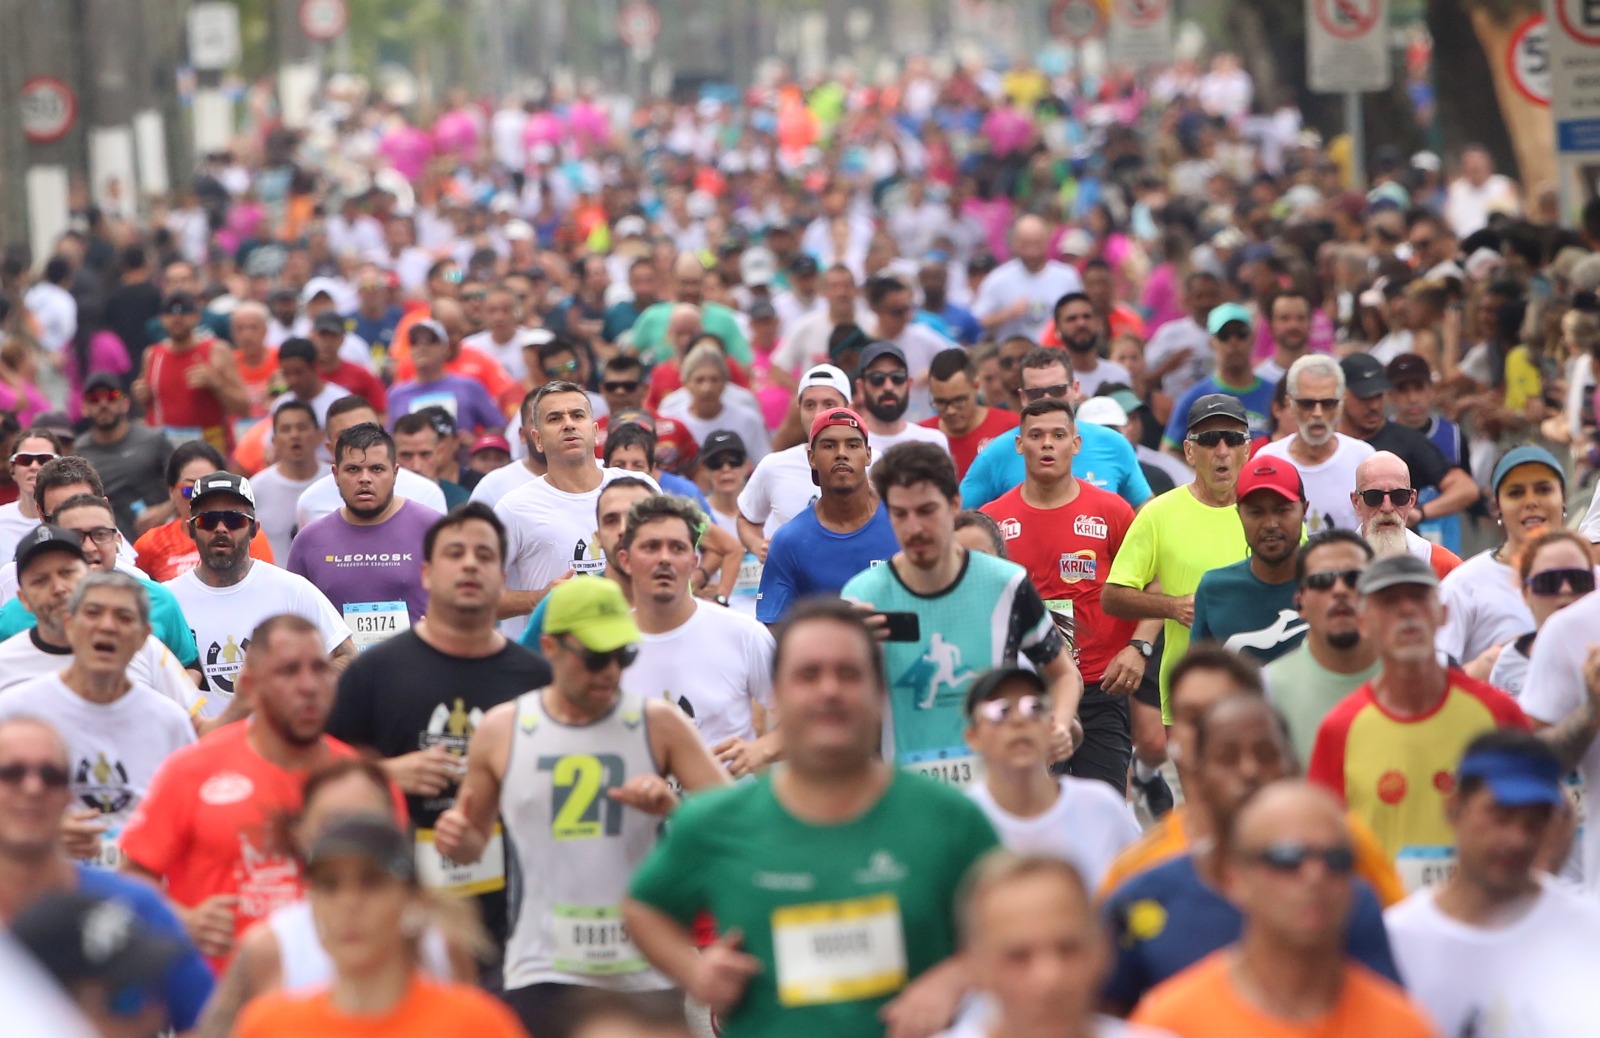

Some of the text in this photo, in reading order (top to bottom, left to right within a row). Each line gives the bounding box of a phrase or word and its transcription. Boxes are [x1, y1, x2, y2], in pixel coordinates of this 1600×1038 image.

[1076, 523, 1105, 537] KRILL
[334, 553, 412, 562] LEOMOSK
[1061, 560, 1094, 574] KRILL
[357, 615, 396, 632] C3174
